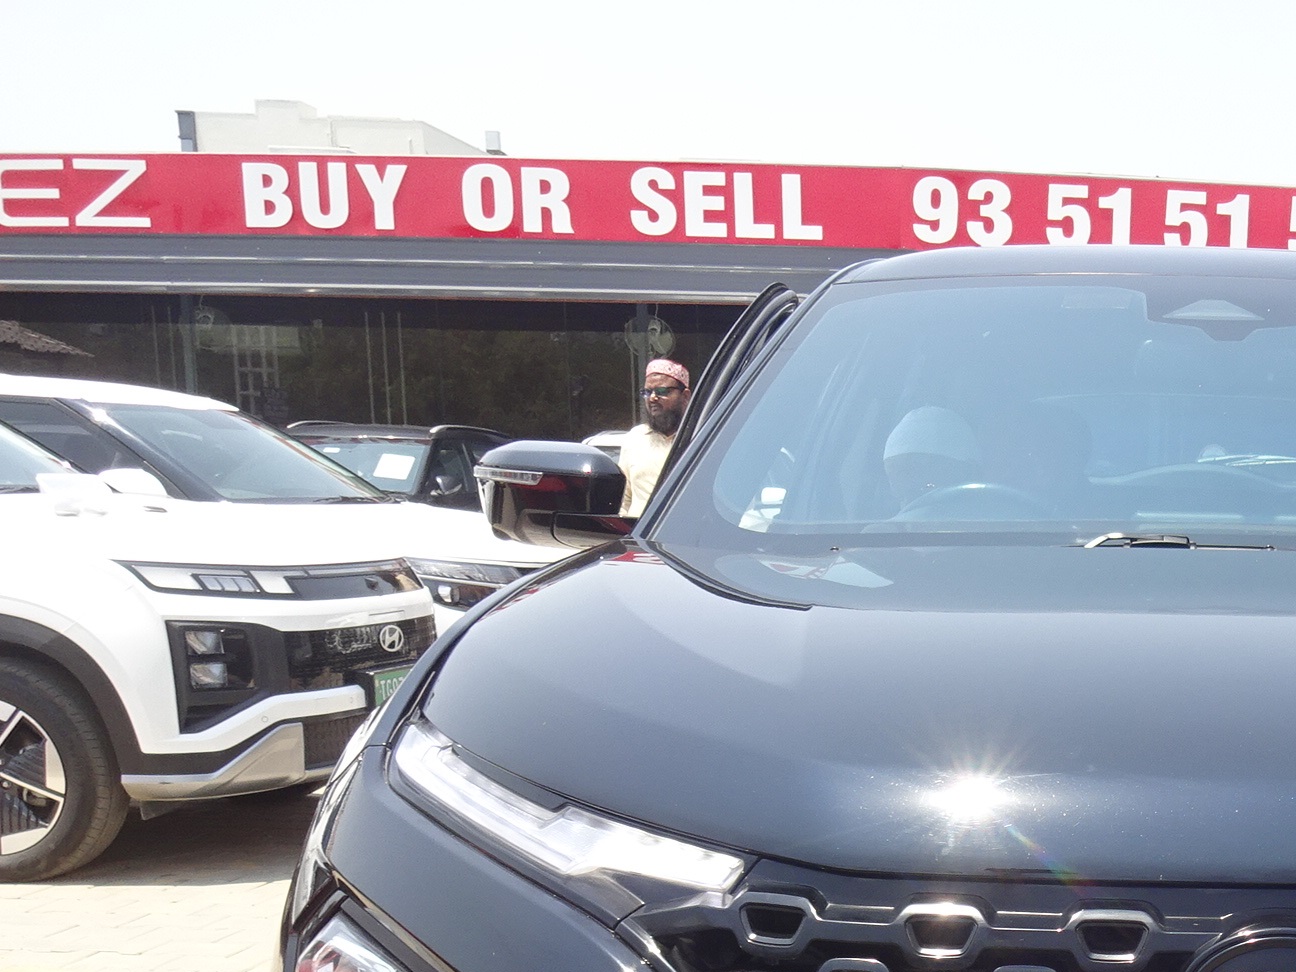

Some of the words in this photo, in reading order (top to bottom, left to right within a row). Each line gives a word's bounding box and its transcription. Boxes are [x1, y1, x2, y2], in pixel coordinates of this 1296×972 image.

[0, 158, 151, 227] EZ
[241, 161, 408, 230] BUY
[461, 163, 575, 234] OR
[629, 166, 824, 241] SELL
[912, 175, 1013, 247] 93
[1045, 183, 1132, 246] 51
[1163, 189, 1250, 248] 51
